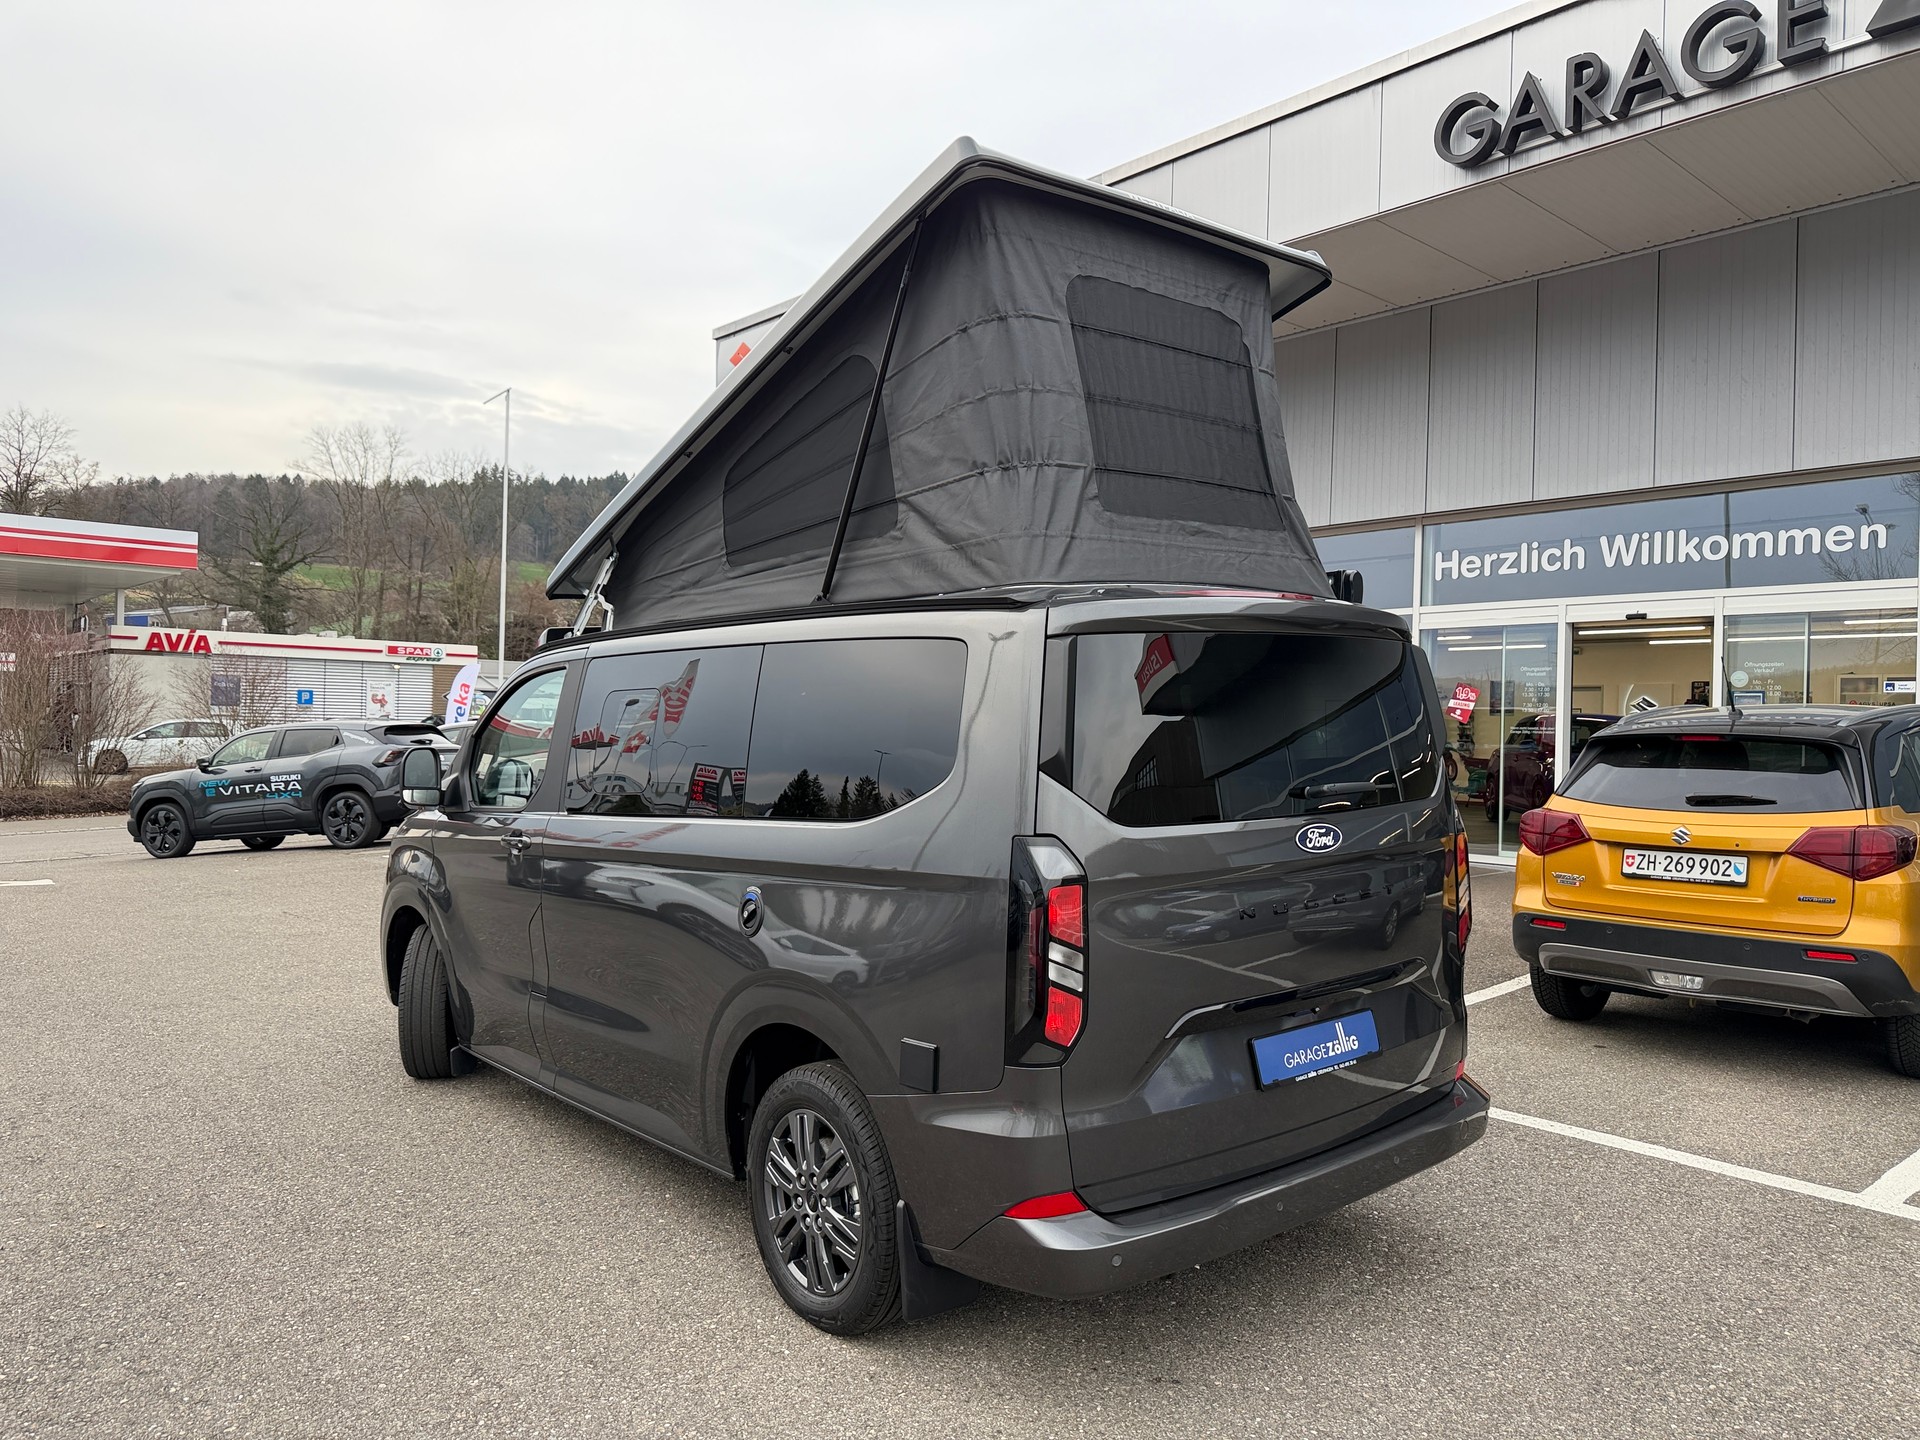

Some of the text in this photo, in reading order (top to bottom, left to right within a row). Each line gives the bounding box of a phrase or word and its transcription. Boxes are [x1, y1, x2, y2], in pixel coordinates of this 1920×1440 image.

[1433, 0, 1829, 168] GARAGE
[1434, 522, 1887, 582] Herzlich Willkommen
[145, 629, 212, 655] AVIA
[397, 646, 432, 656] SPAR
[405, 655, 444, 663] express
[301, 692, 310, 703] P
[198, 778, 232, 788] NEW
[270, 773, 301, 783] SUZUKI
[218, 781, 302, 796] VITARA
[1239, 883, 1395, 920] NUGGET
